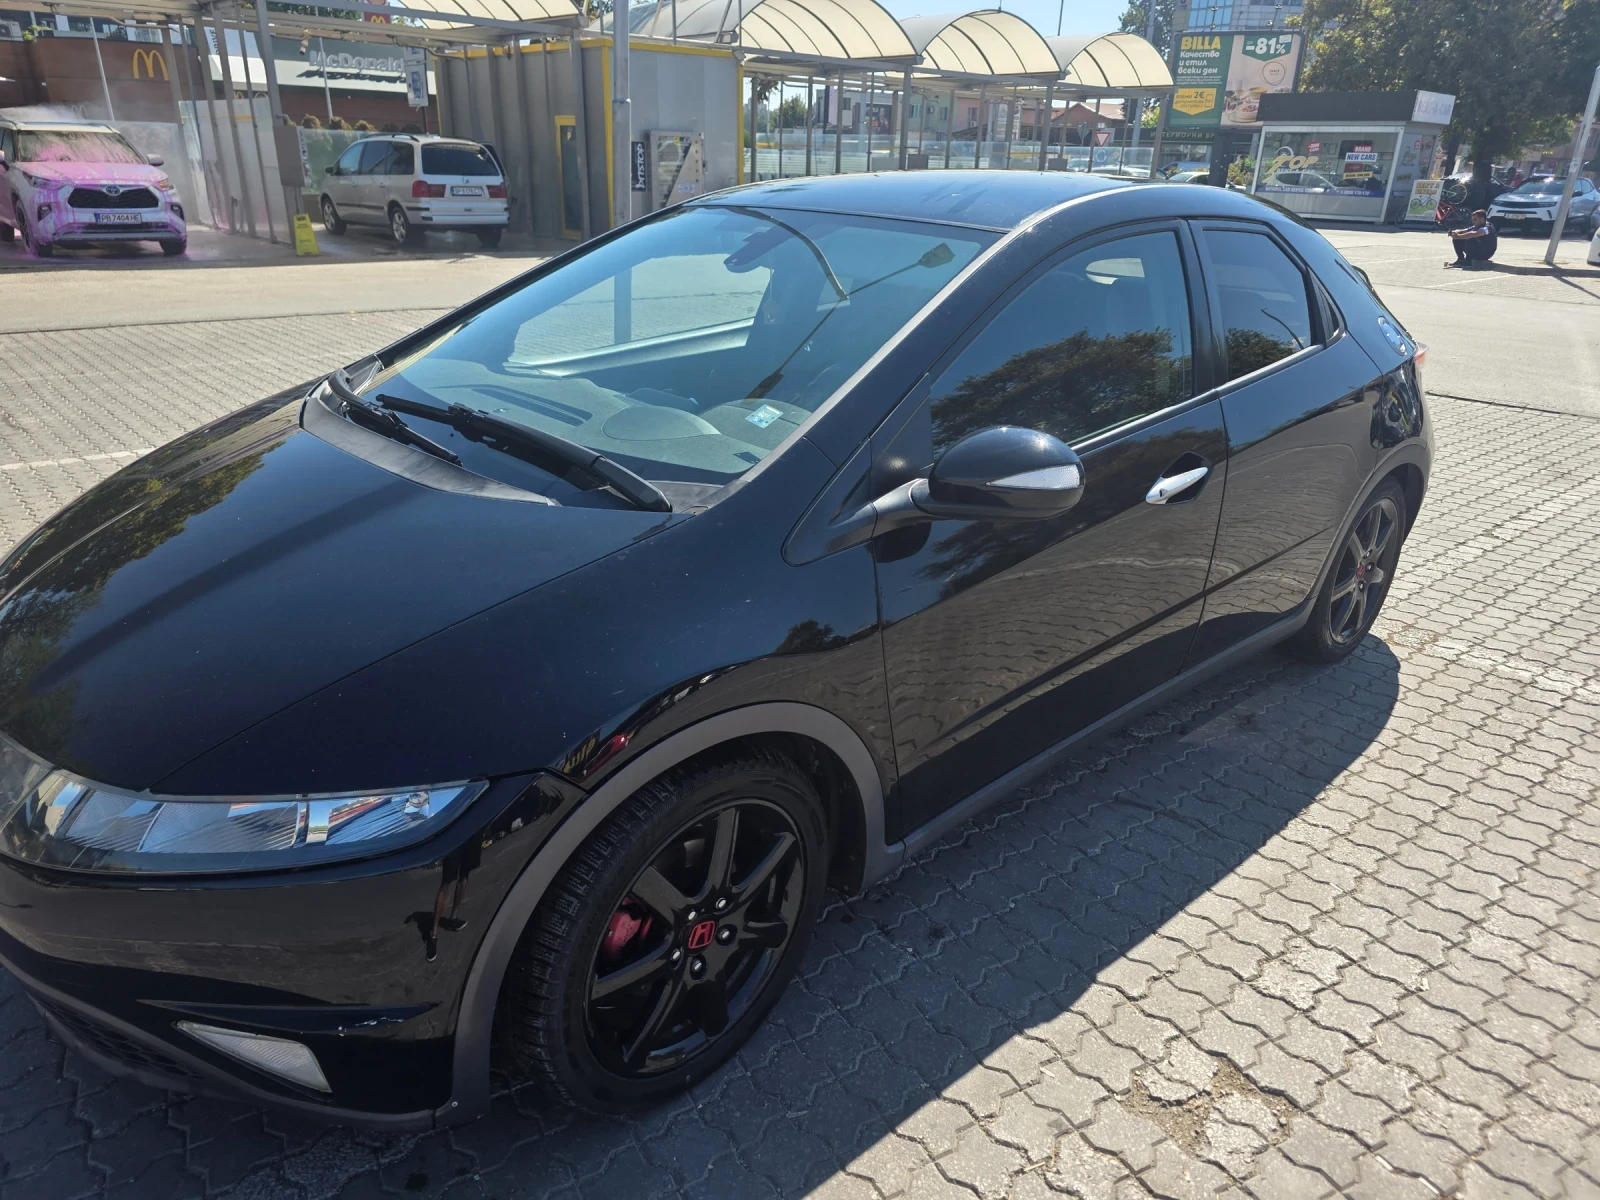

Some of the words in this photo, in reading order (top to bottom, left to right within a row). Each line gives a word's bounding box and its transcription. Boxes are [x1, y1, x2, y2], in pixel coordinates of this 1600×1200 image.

[1181, 36, 1221, 50] BILLA
[309, 50, 404, 71] McDonald
[1180, 50, 1220, 58] Качество
[1202, 67, 1218, 75] ден
[1266, 156, 1318, 174] TOP
